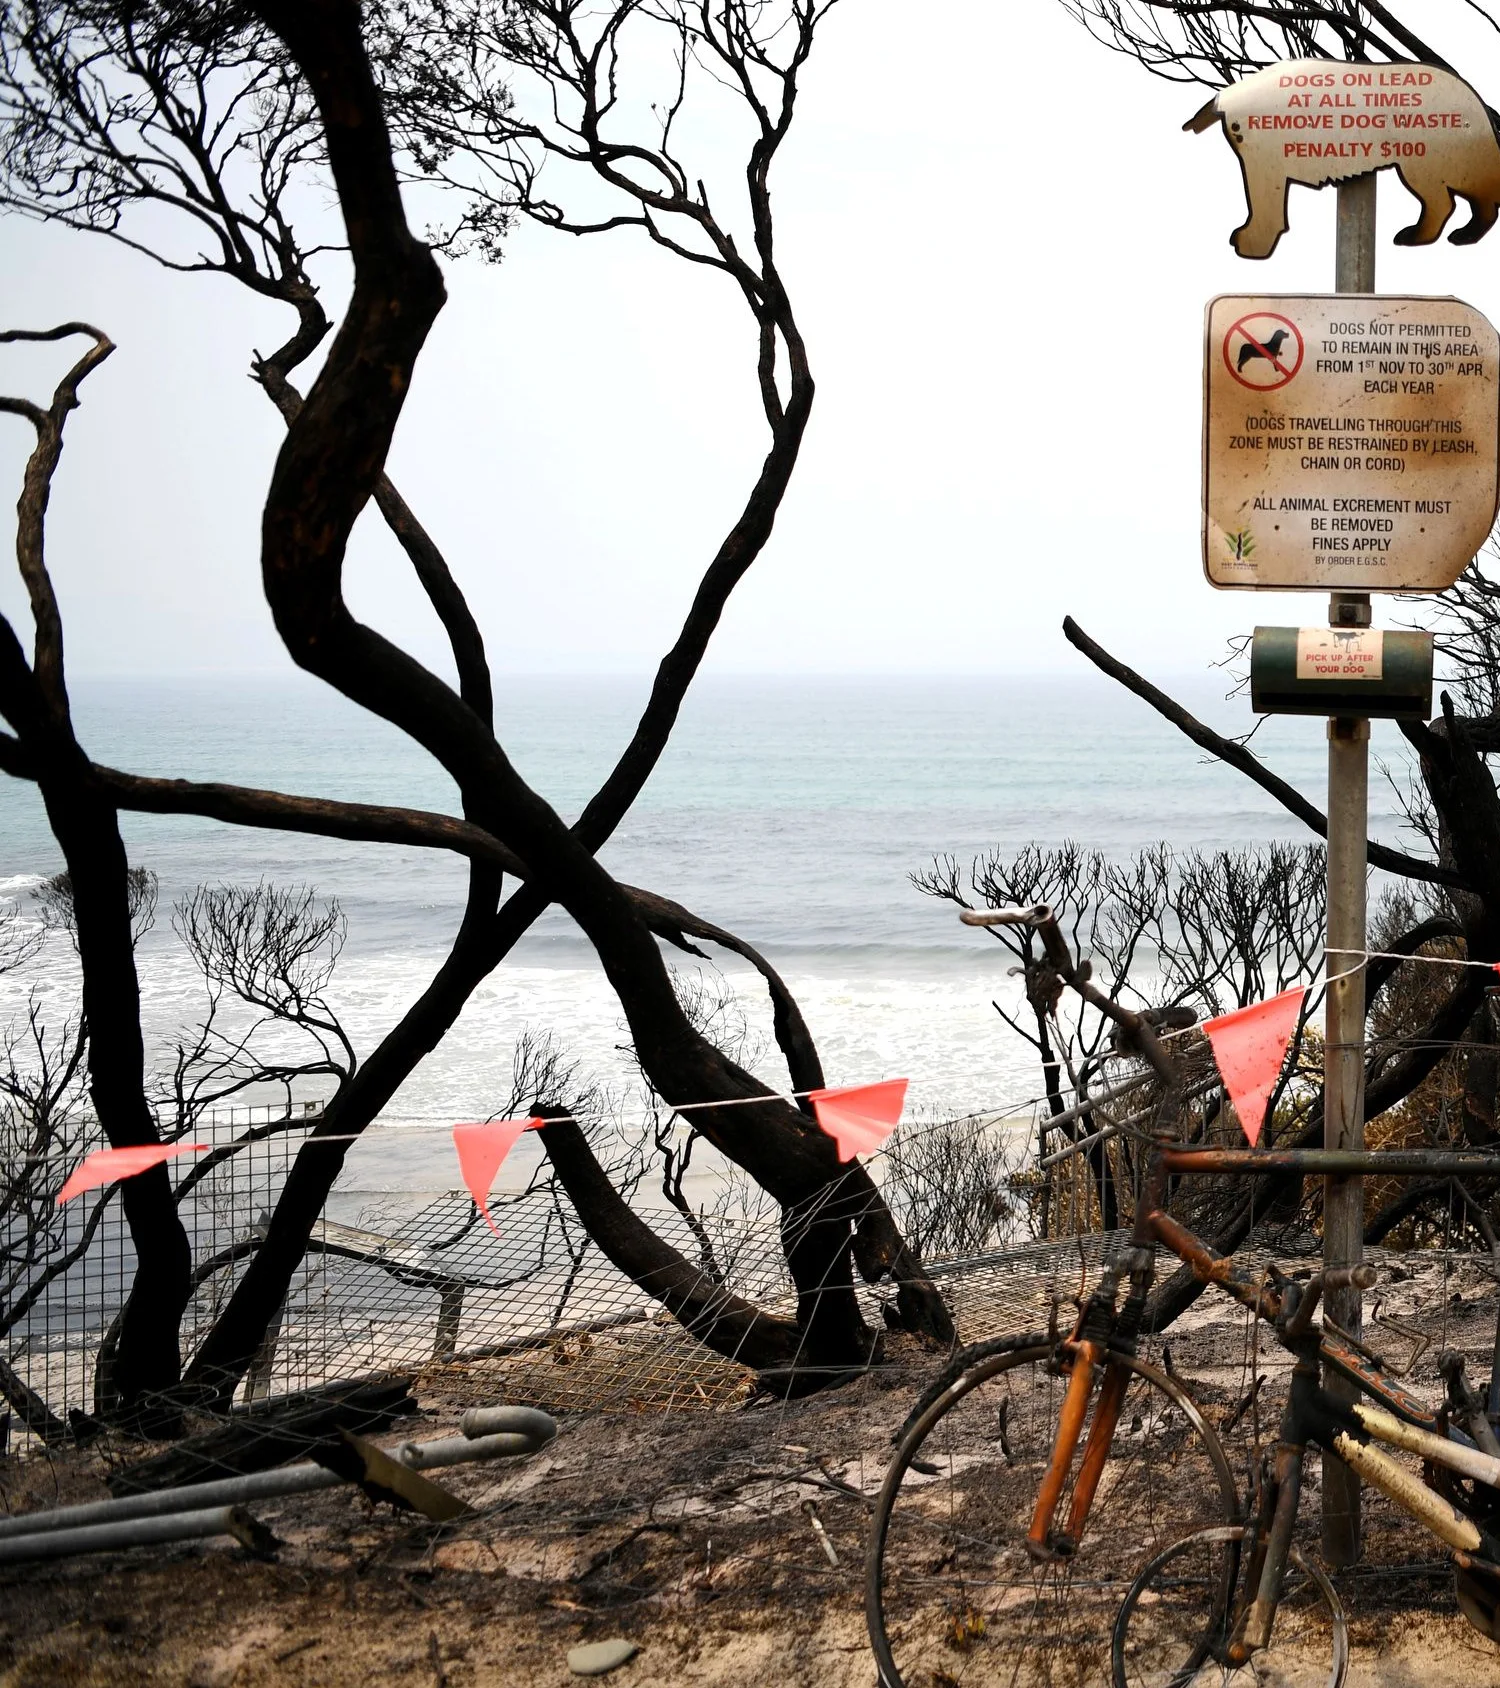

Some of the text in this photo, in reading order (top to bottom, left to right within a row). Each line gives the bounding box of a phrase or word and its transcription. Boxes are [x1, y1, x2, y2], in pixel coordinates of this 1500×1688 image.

[1279, 72, 1432, 88] DOGS ON LEAD
[1288, 93, 1422, 108] AT ALL TIMES
[1249, 115, 1333, 130] REMOVE
[1341, 115, 1385, 129] DOG
[1284, 141, 1425, 159] PENALTY $100
[1330, 323, 1471, 338] DOGS NOT PERMITTED
[1322, 341, 1478, 356] TO REMAIN IN THIS AREA
[1317, 360, 1353, 373] FROM
[1379, 361, 1404, 374] NOV
[1409, 361, 1424, 374] TO
[1458, 362, 1482, 376] APR
[1365, 380, 1434, 394] EACH YEAR
[1246, 416, 1462, 433] (DOGS TRAVELLING THROUGH THIS
[1229, 436, 1477, 456] ZONE MUST BE RESTRAINED BY LEASH,
[1301, 457, 1405, 473] CHAIN OR CORD)
[1253, 497, 1451, 513] ALL ANIMAL EXCREMENT MUST
[1311, 518, 1393, 532] BE REMOVED
[1312, 538, 1391, 552] FINES APPLY
[1316, 556, 1325, 564] BY
[1328, 556, 1354, 565] ORDER
[1306, 654, 1328, 662] PICK
[1347, 654, 1373, 662] AFTER
[1315, 665, 1365, 674] YOUR DOG
